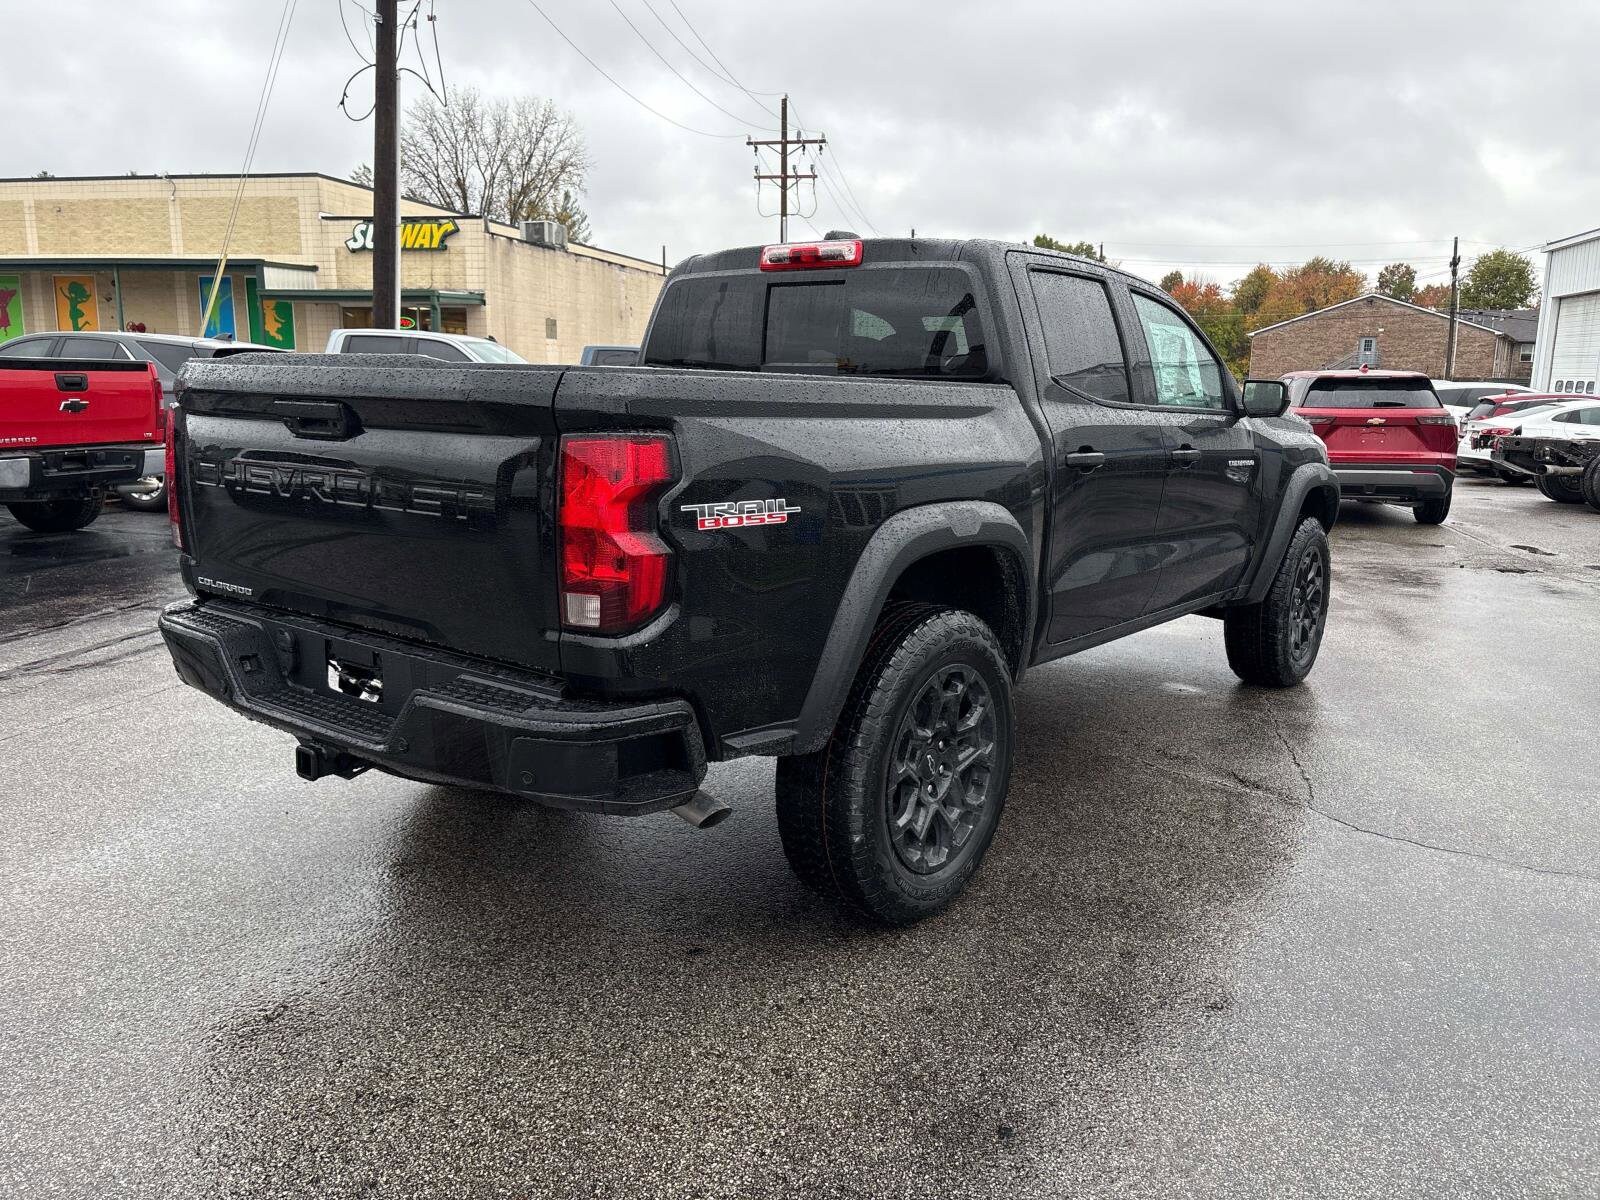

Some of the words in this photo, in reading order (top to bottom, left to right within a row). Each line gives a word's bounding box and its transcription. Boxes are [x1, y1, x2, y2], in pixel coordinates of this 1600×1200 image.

[346, 218, 457, 251] SWAY
[195, 461, 485, 519] CHEVROLET
[681, 499, 801, 518] TRAIL
[698, 512, 787, 530] BOSS
[198, 576, 253, 596] COLORADO
